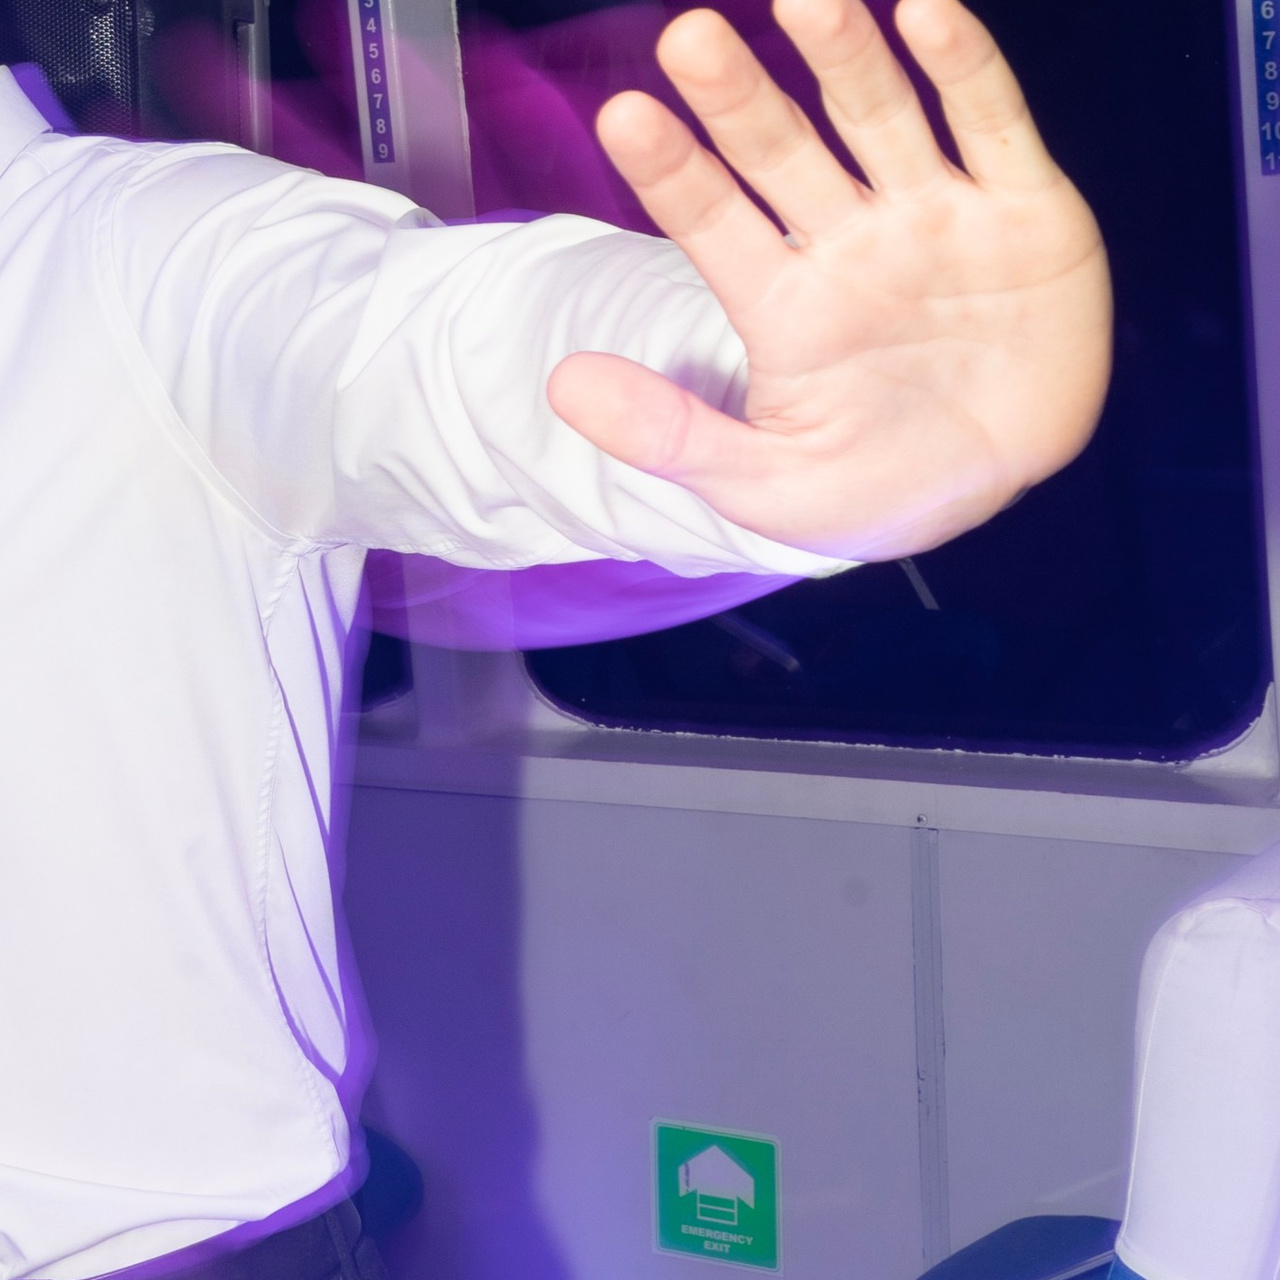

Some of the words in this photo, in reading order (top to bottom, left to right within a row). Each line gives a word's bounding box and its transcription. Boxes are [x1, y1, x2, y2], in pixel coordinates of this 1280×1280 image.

[1261, 0, 1275, 20] 6
[366, 17, 377, 34] 4
[1262, 31, 1276, 50] 7
[369, 42, 379, 59] 5
[371, 68, 381, 84] 6
[1264, 61, 1278, 81] 8
[373, 93, 383, 109] 7
[1266, 91, 1280, 111] 9
[375, 118, 386, 134] 8
[378, 143, 389, 159] 9
[1265, 152, 1280, 171] 1
[681, 1224, 754, 1246] EMERGENCY
[703, 1240, 731, 1254] EXIT
